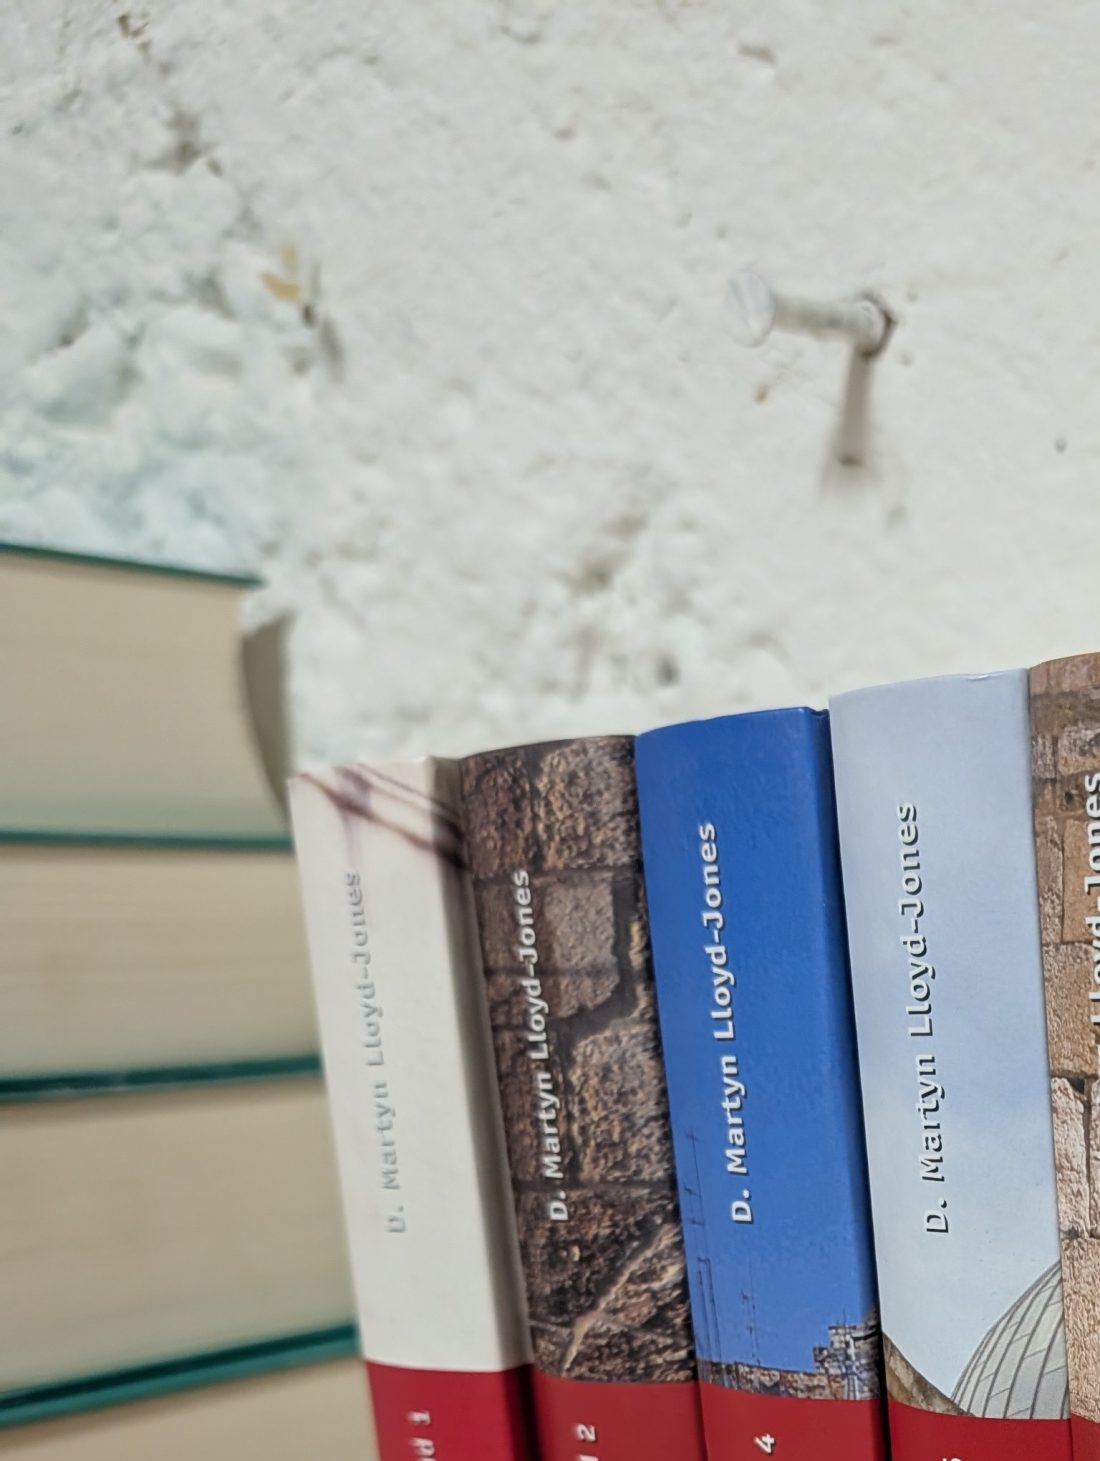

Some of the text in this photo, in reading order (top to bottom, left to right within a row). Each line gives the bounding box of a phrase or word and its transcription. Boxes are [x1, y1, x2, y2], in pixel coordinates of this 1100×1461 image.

[345, 871, 407, 1235] D. Martyn Lloyd-Jones
[511, 869, 570, 1222] D. Martyn Lloyd-Jones
[699, 822, 754, 1225] D. Martyn Lloyd-Jones
[896, 801, 950, 1236] D. Martyn Lloyd-Jones
[407, 1409, 432, 1426] 1
[575, 1422, 598, 1443] 2
[753, 1432, 777, 1456] 4
